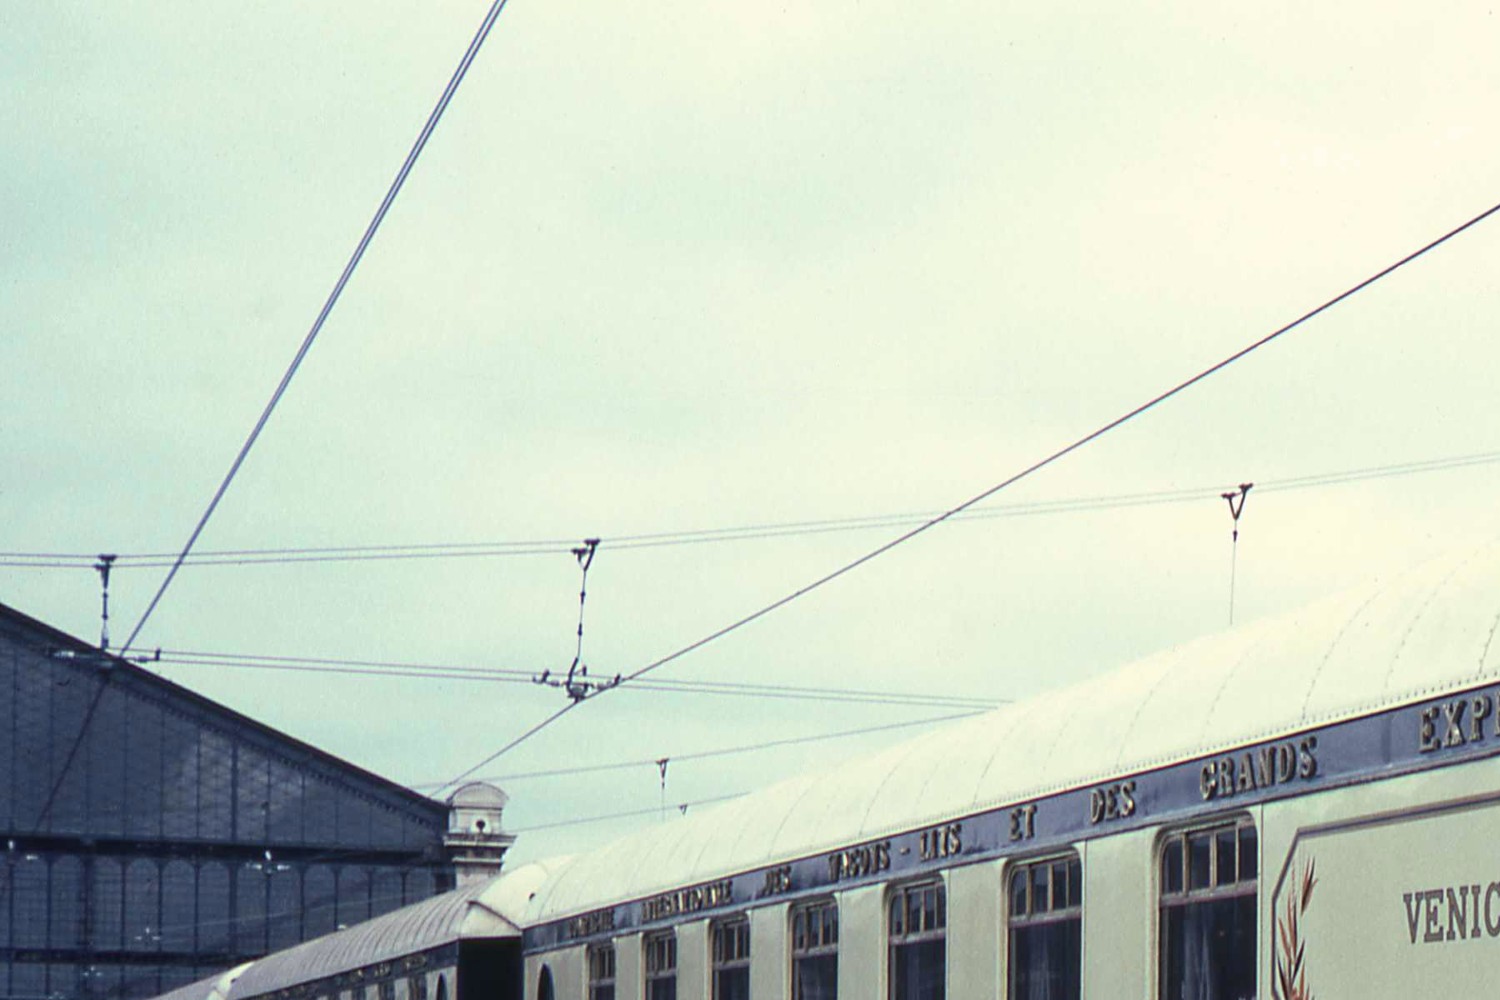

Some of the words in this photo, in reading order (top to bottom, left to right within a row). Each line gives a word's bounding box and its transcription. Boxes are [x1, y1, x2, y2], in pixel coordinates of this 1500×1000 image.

[919, 823, 962, 862] LITS
[1009, 805, 1037, 841] ET
[1090, 782, 1136, 825] DES
[1199, 736, 1318, 800] GRANDS
